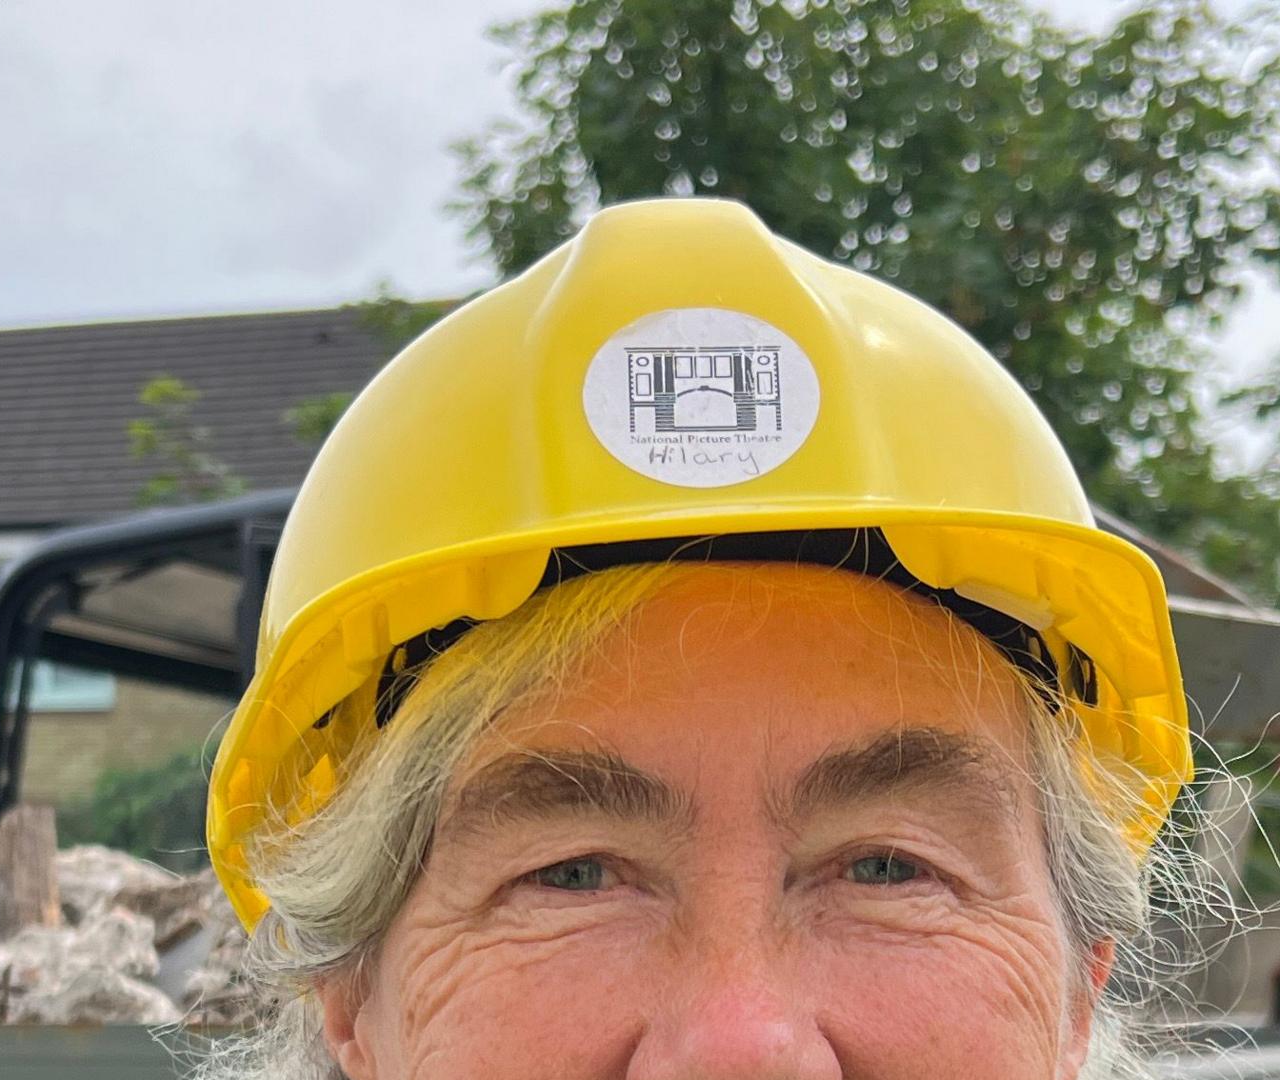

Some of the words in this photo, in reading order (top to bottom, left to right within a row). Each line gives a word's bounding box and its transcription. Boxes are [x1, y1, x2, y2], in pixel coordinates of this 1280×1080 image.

[630, 434, 683, 445] National
[687, 435, 731, 444] Picture
[734, 434, 782, 444] Theatre
[649, 446, 760, 475] Hilary
